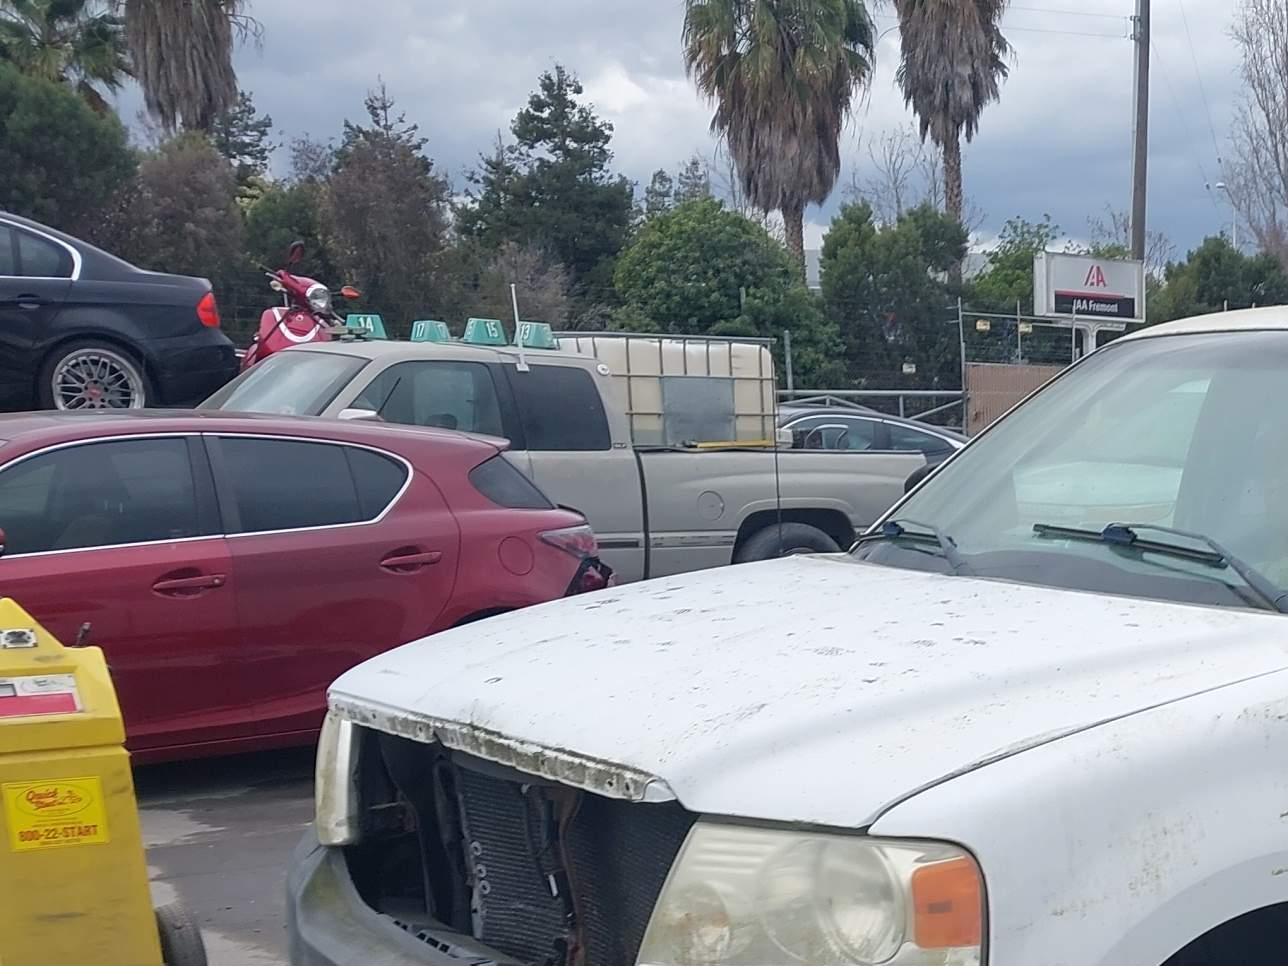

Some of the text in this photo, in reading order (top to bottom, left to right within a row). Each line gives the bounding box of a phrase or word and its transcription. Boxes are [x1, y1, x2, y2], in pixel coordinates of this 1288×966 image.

[1088, 301, 1118, 313] Fremont
[359, 316, 374, 332] 14
[486, 321, 499, 337] 15
